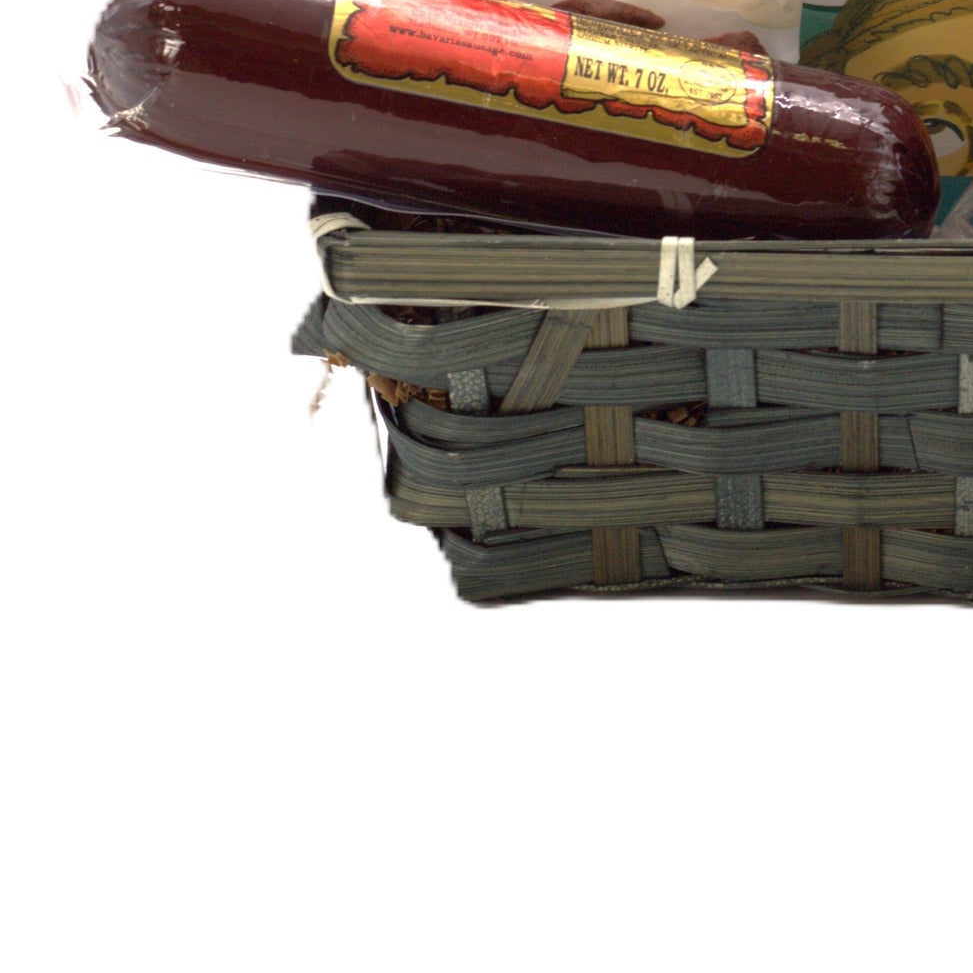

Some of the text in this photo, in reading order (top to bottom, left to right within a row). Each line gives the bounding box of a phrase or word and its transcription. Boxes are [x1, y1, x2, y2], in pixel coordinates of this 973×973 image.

[389, 25, 533, 61] www.bavariasausage.com
[574, 56, 603, 80] NET
[635, 69, 643, 89] 7
